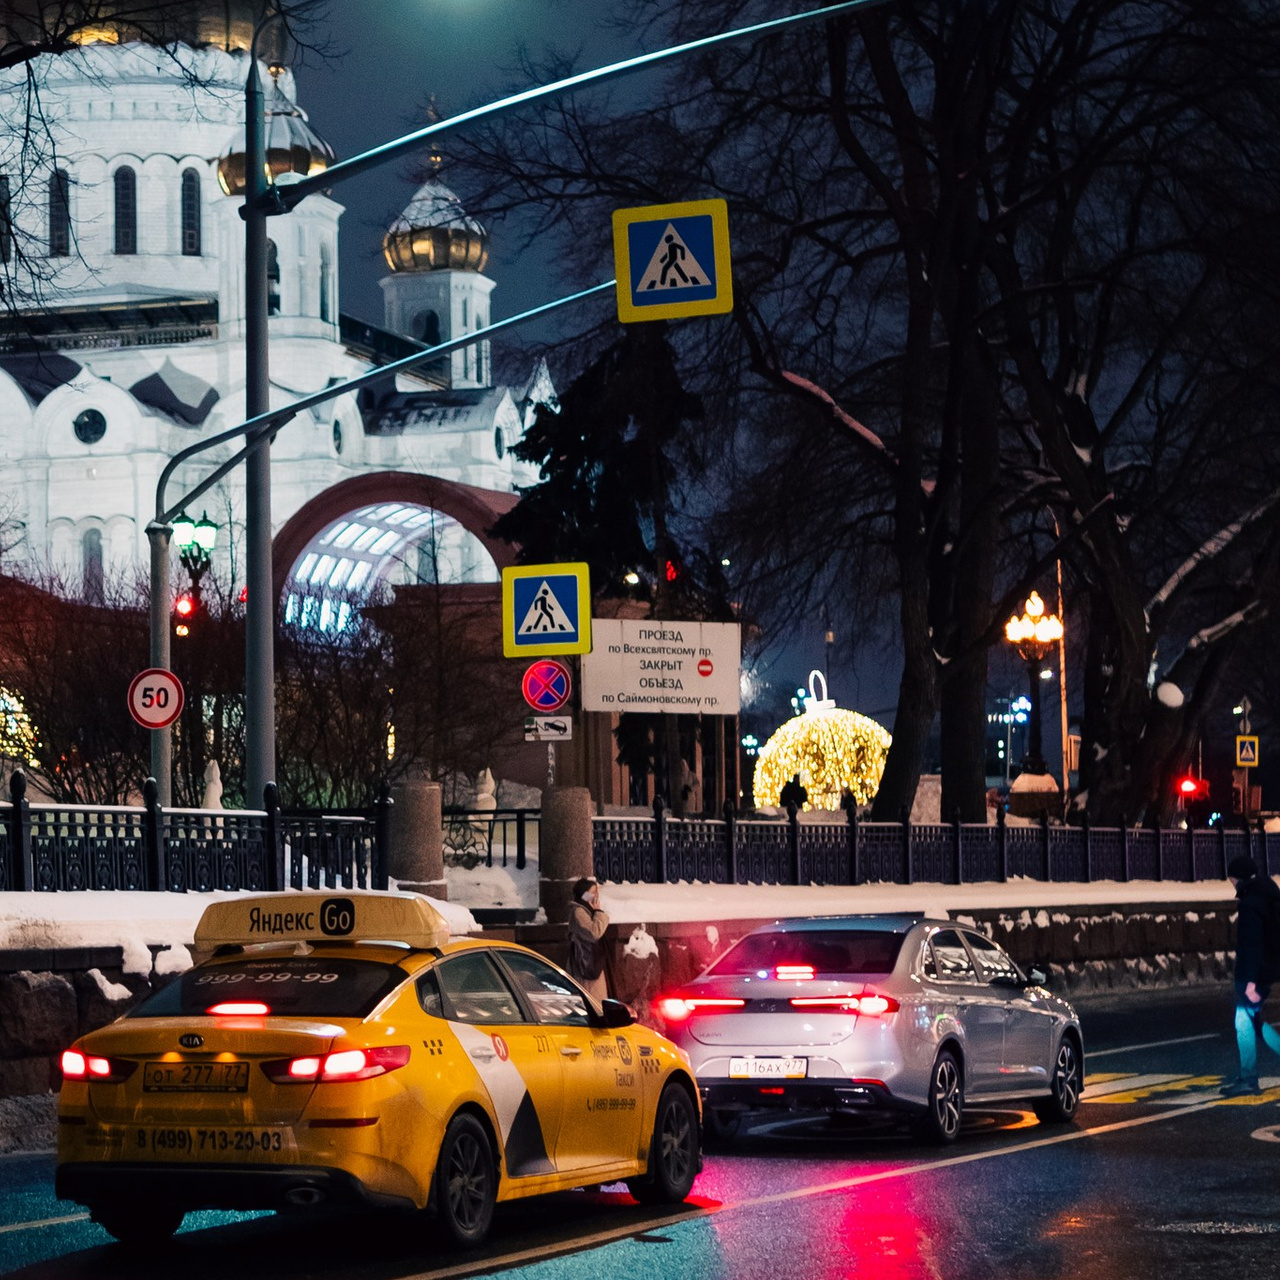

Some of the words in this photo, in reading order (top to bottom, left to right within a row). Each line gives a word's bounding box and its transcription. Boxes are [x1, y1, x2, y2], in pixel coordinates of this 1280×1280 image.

[639, 630, 683, 643] ПРОЕЗД
[608, 645, 620, 653] по
[623, 644, 696, 657] Всехсвятскому
[699, 648, 713, 658] пр.
[640, 660, 683, 671] ЗАКРЫТ
[639, 678, 683, 690] ОБЪЕЗД
[141, 687, 169, 708] 50
[602, 694, 614, 703] по
[617, 692, 701, 705] Саймоновскому
[705, 696, 719, 707] пр.
[249, 907, 314, 934] Яндекс
[324, 904, 350, 930] Go
[195, 972, 339, 985] 999-99-99
[182, 1036, 201, 1045] KIA
[494, 1036, 507, 1057] Я
[533, 1035, 550, 1053] 277
[181, 1065, 214, 1083] 277
[137, 1129, 146, 1148] 8
[152, 1129, 192, 1154] (499)
[197, 1130, 282, 1151] 713-20-03
